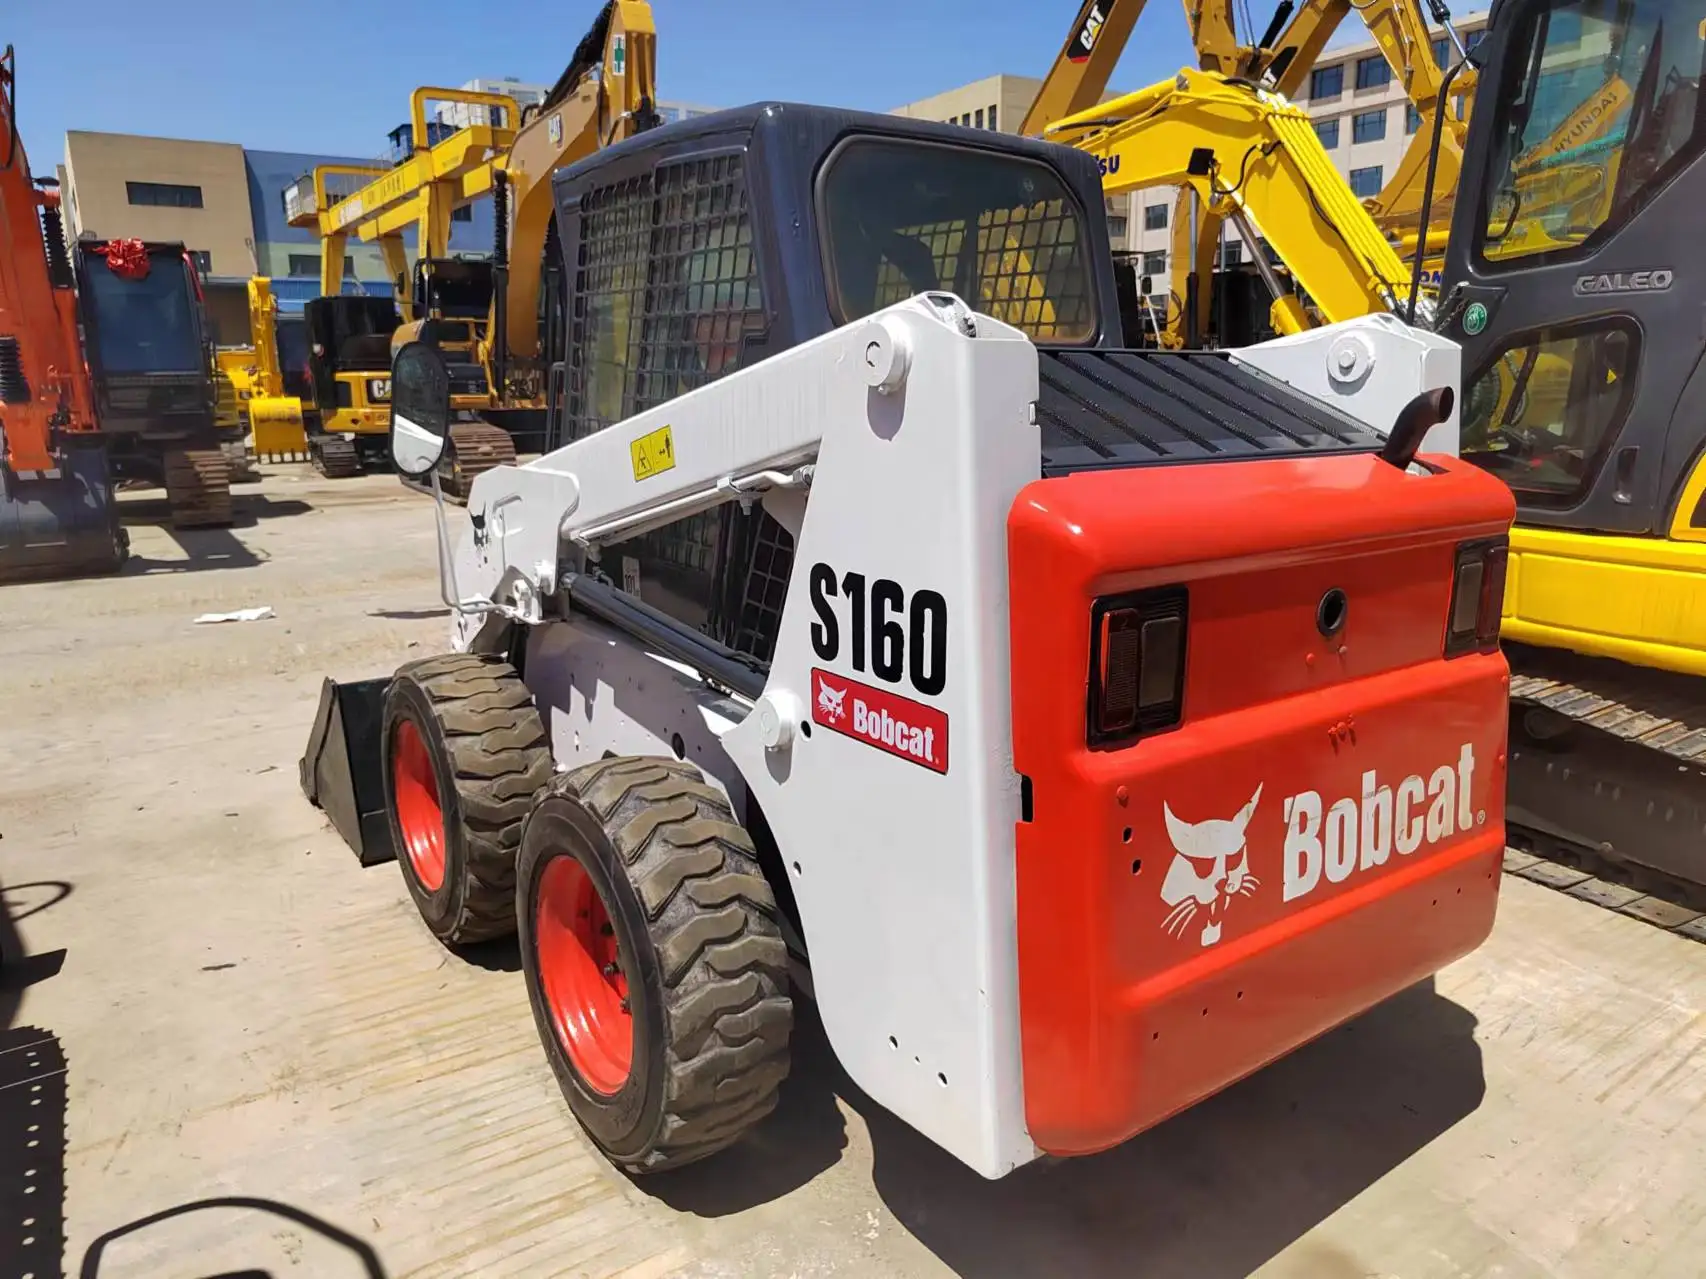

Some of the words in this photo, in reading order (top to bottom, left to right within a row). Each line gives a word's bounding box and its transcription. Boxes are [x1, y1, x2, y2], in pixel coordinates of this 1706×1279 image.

[1080, 4, 1104, 50] CAT
[1575, 270, 1672, 292] GALEO
[810, 562, 947, 696] S160
[853, 698, 935, 763] Bobcat
[1283, 743, 1475, 902] Bobcat
